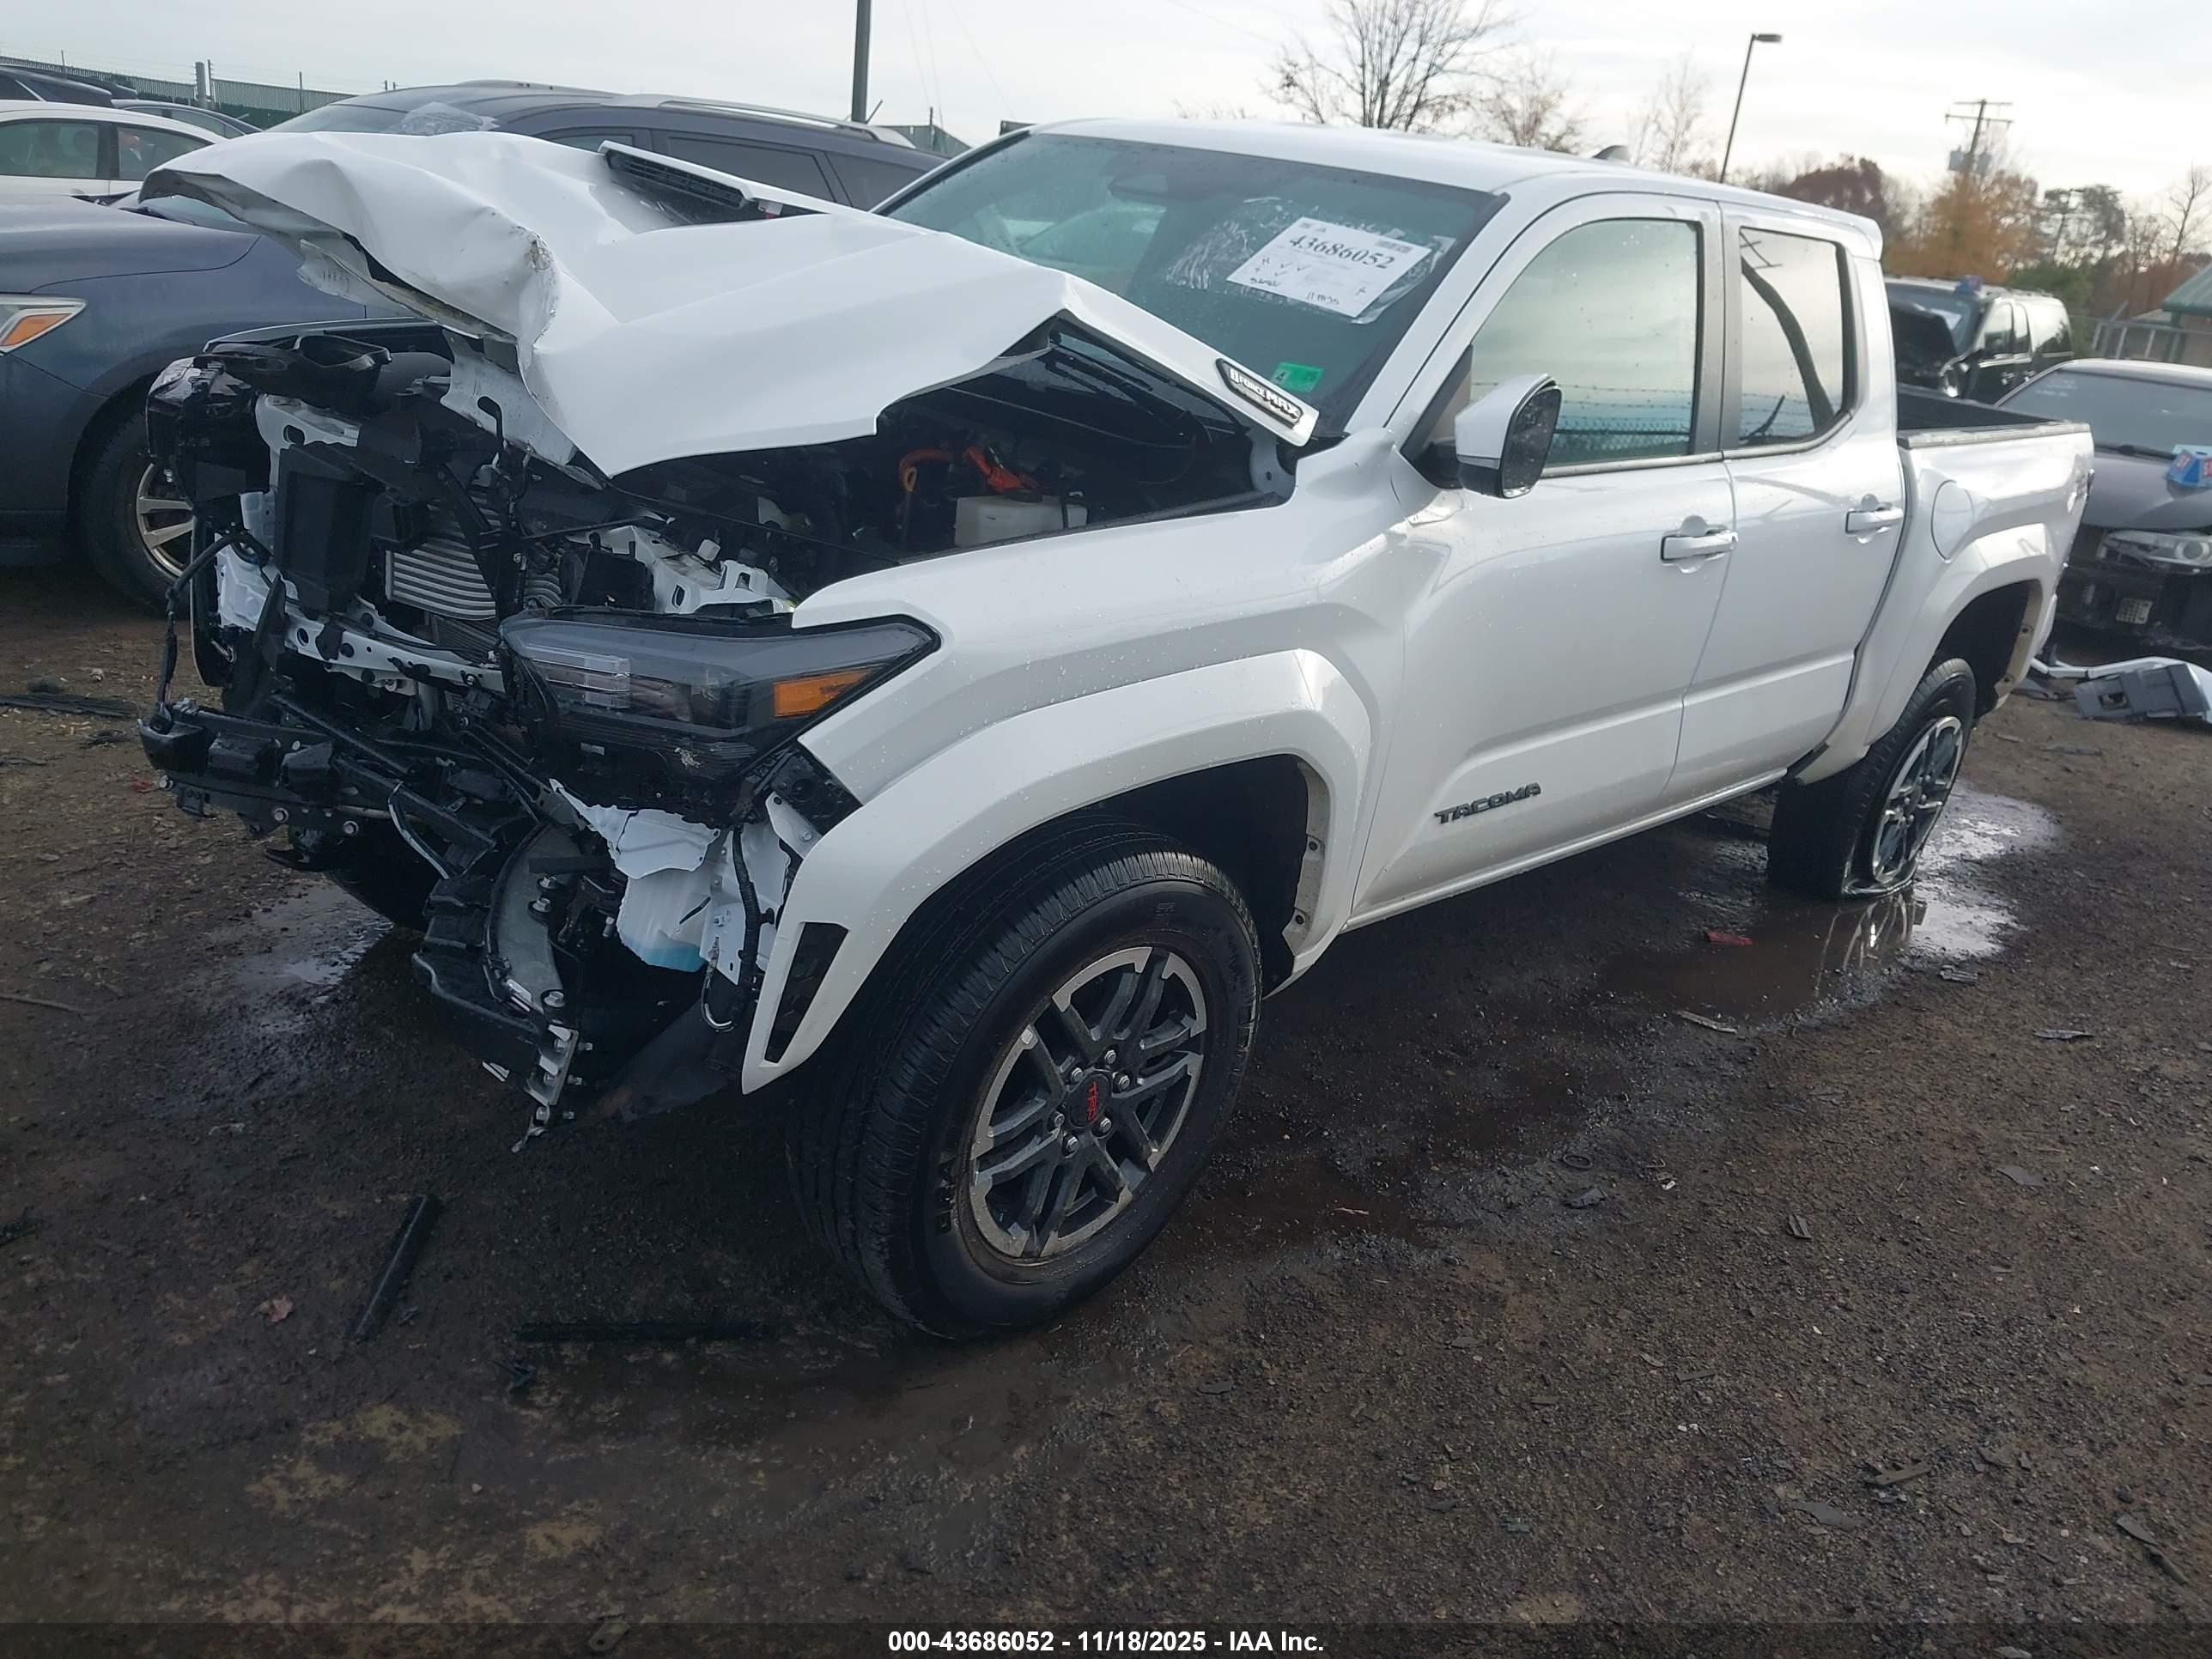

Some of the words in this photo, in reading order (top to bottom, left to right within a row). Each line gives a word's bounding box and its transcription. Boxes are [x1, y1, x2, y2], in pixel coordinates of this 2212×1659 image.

[1289, 234, 1395, 270] 43686052
[1265, 389, 1299, 418] MAX
[1434, 782, 1541, 824] TACOMA
